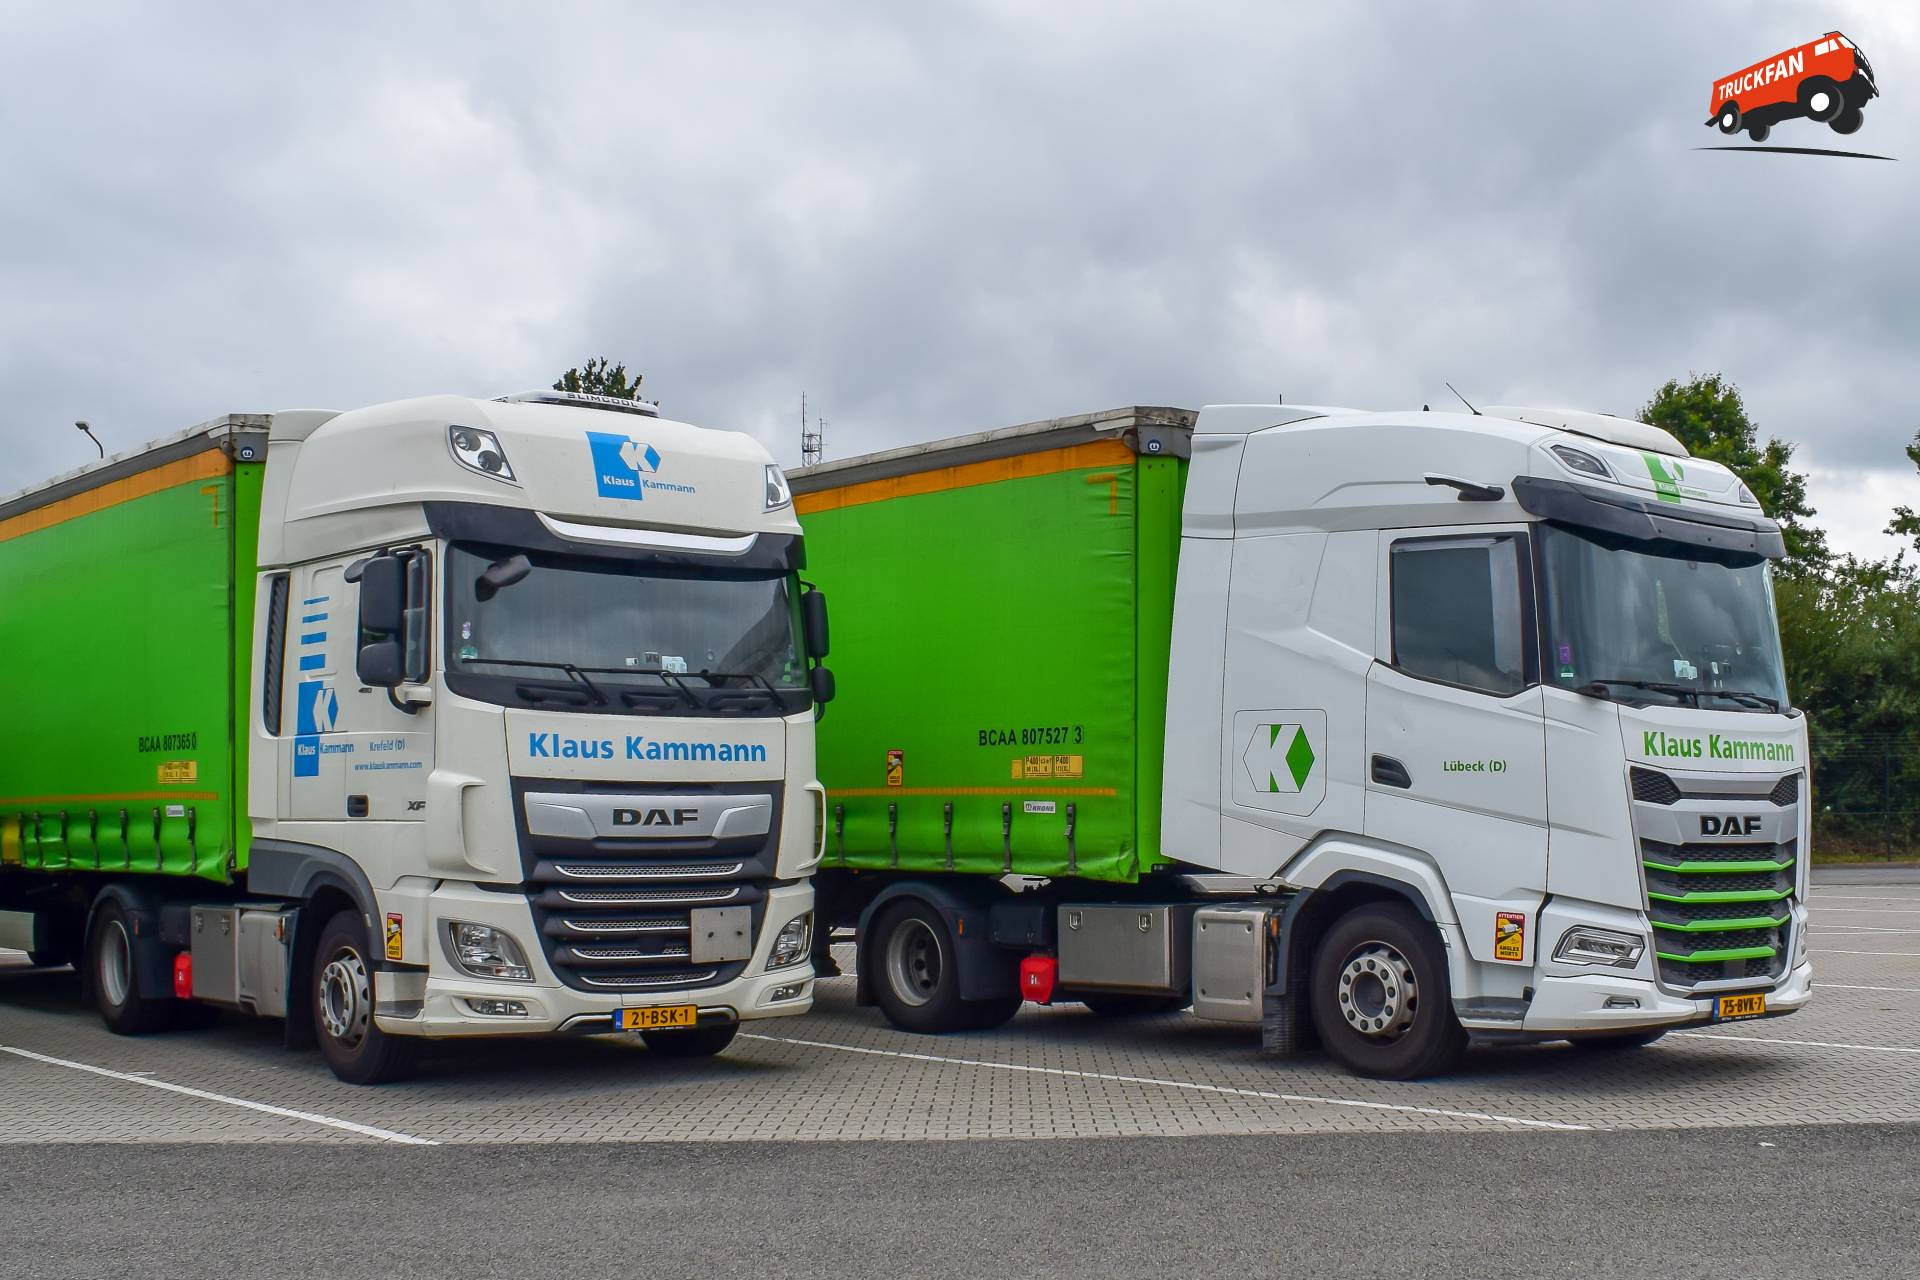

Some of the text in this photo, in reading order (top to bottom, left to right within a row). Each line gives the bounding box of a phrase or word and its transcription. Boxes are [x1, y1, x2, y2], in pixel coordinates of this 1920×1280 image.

[567, 392, 638, 408] SLIMCOOL
[602, 474, 696, 494] Klaus Kammann
[138, 736, 161, 753] BCAA
[369, 738, 405, 751] Krefeld (D)
[979, 725, 1082, 746] BCAA 807527 3
[297, 743, 354, 756] Klaus Kammann
[529, 732, 767, 762] Klaus Kammann
[1643, 731, 1794, 762] Klaus Kammann
[1443, 759, 1507, 773] Lübeck (D)
[407, 800, 426, 811] XF
[612, 808, 699, 826] DAF
[1700, 815, 1762, 837] DAF
[631, 1008, 689, 1026] 21-BSK-1
